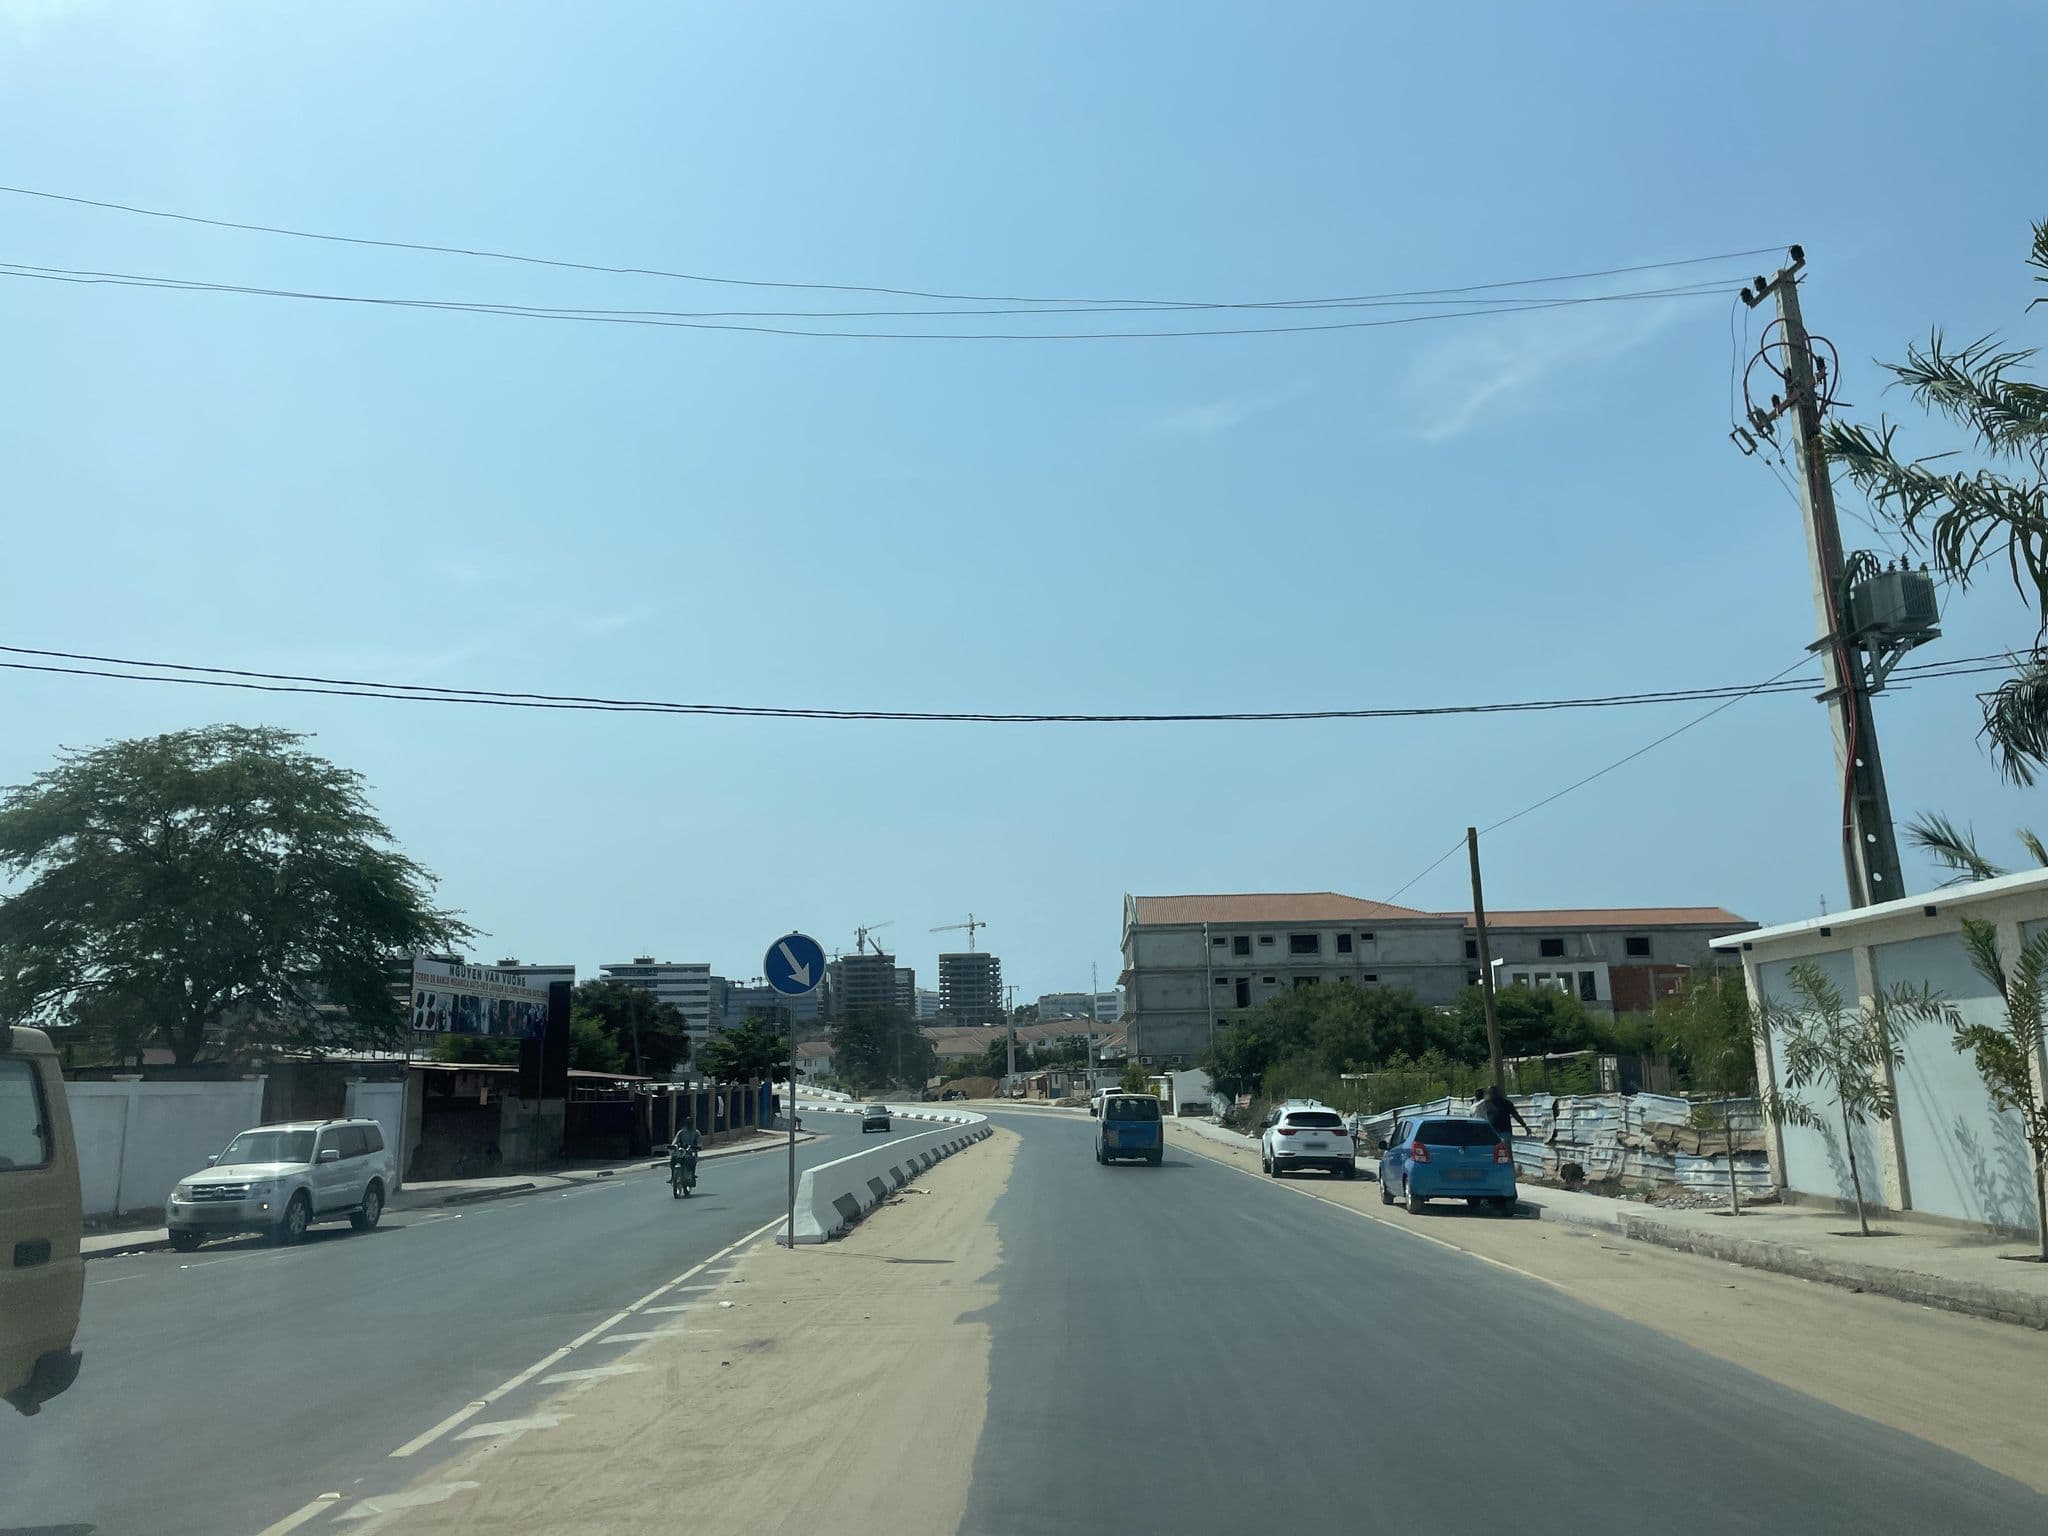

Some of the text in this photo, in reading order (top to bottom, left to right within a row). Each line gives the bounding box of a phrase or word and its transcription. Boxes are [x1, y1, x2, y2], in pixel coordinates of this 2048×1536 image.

[449, 965, 526, 987] NGUYEN VAN VUONG
